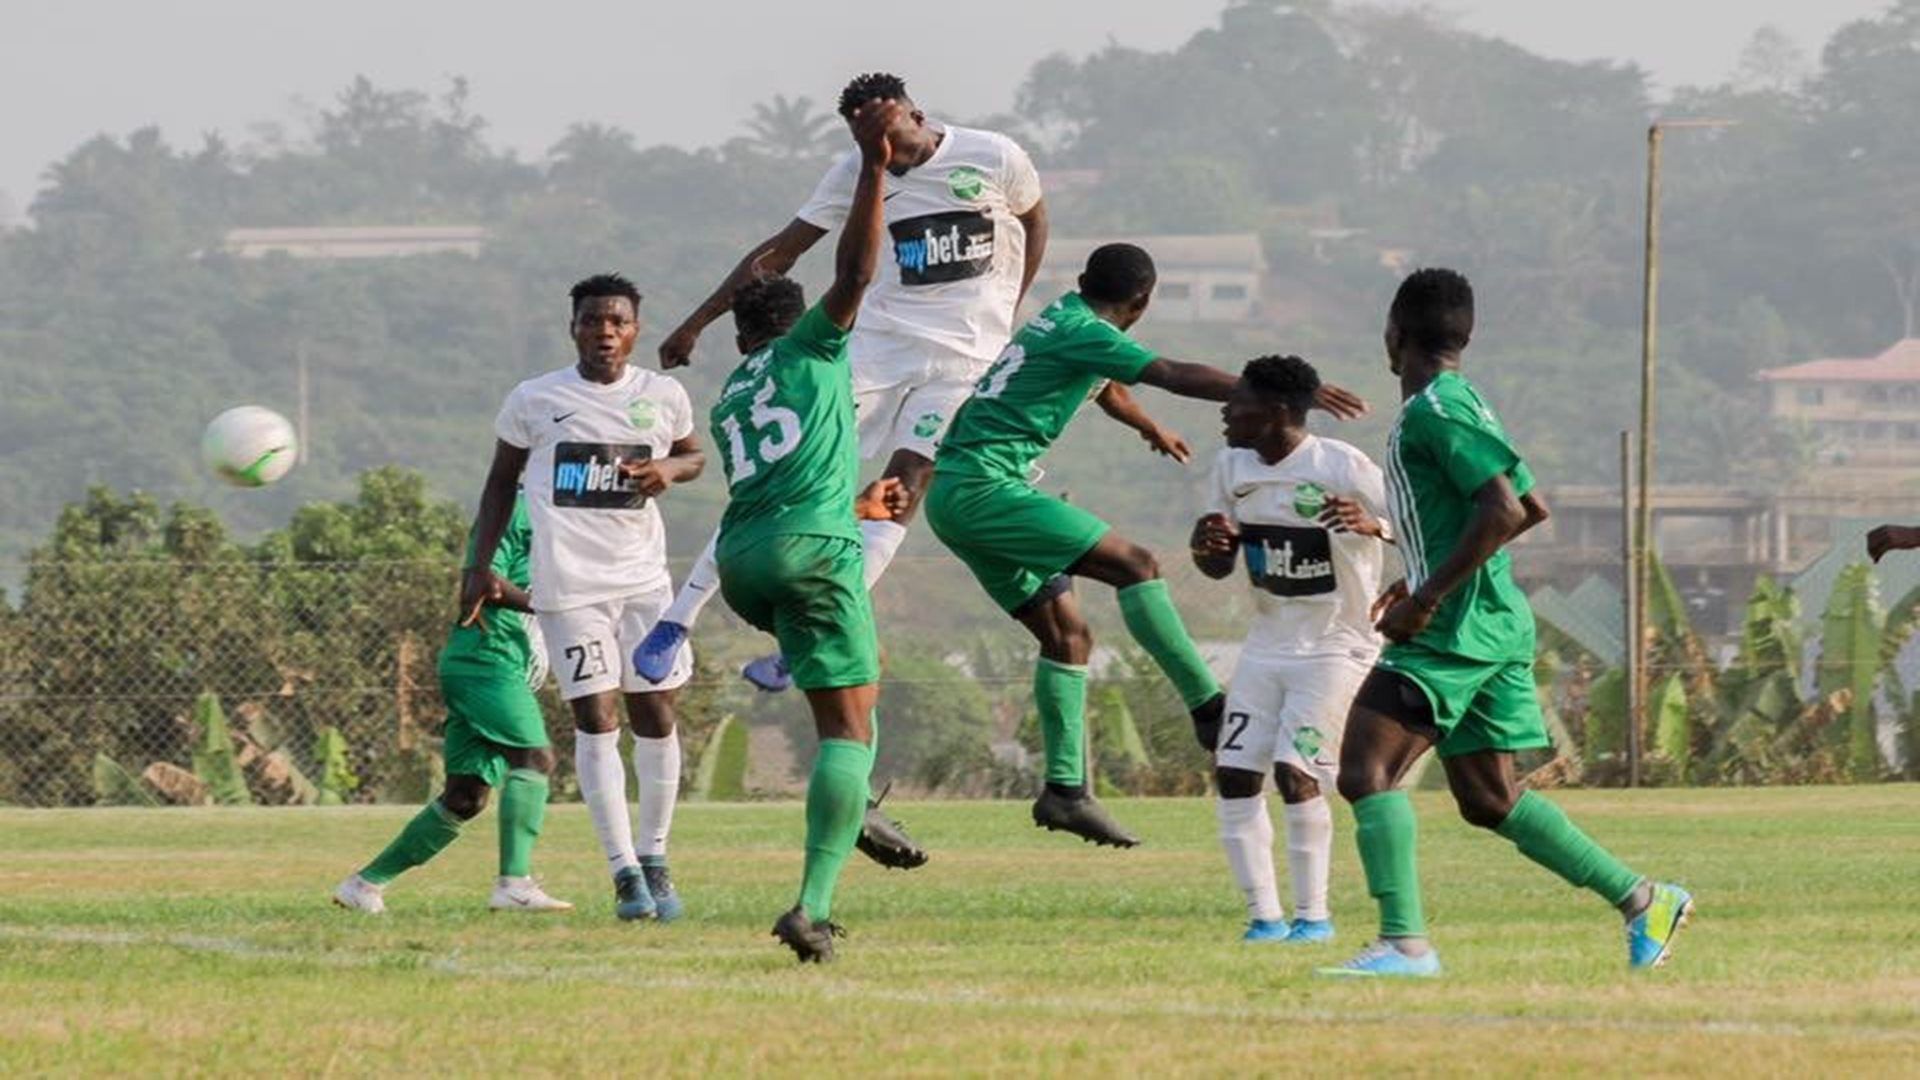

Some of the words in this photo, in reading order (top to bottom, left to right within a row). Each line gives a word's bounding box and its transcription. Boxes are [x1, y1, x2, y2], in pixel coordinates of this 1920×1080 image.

[720, 376, 802, 485] 15
[1247, 539, 1332, 579] bet.africa
[1223, 711, 1250, 751] 2
